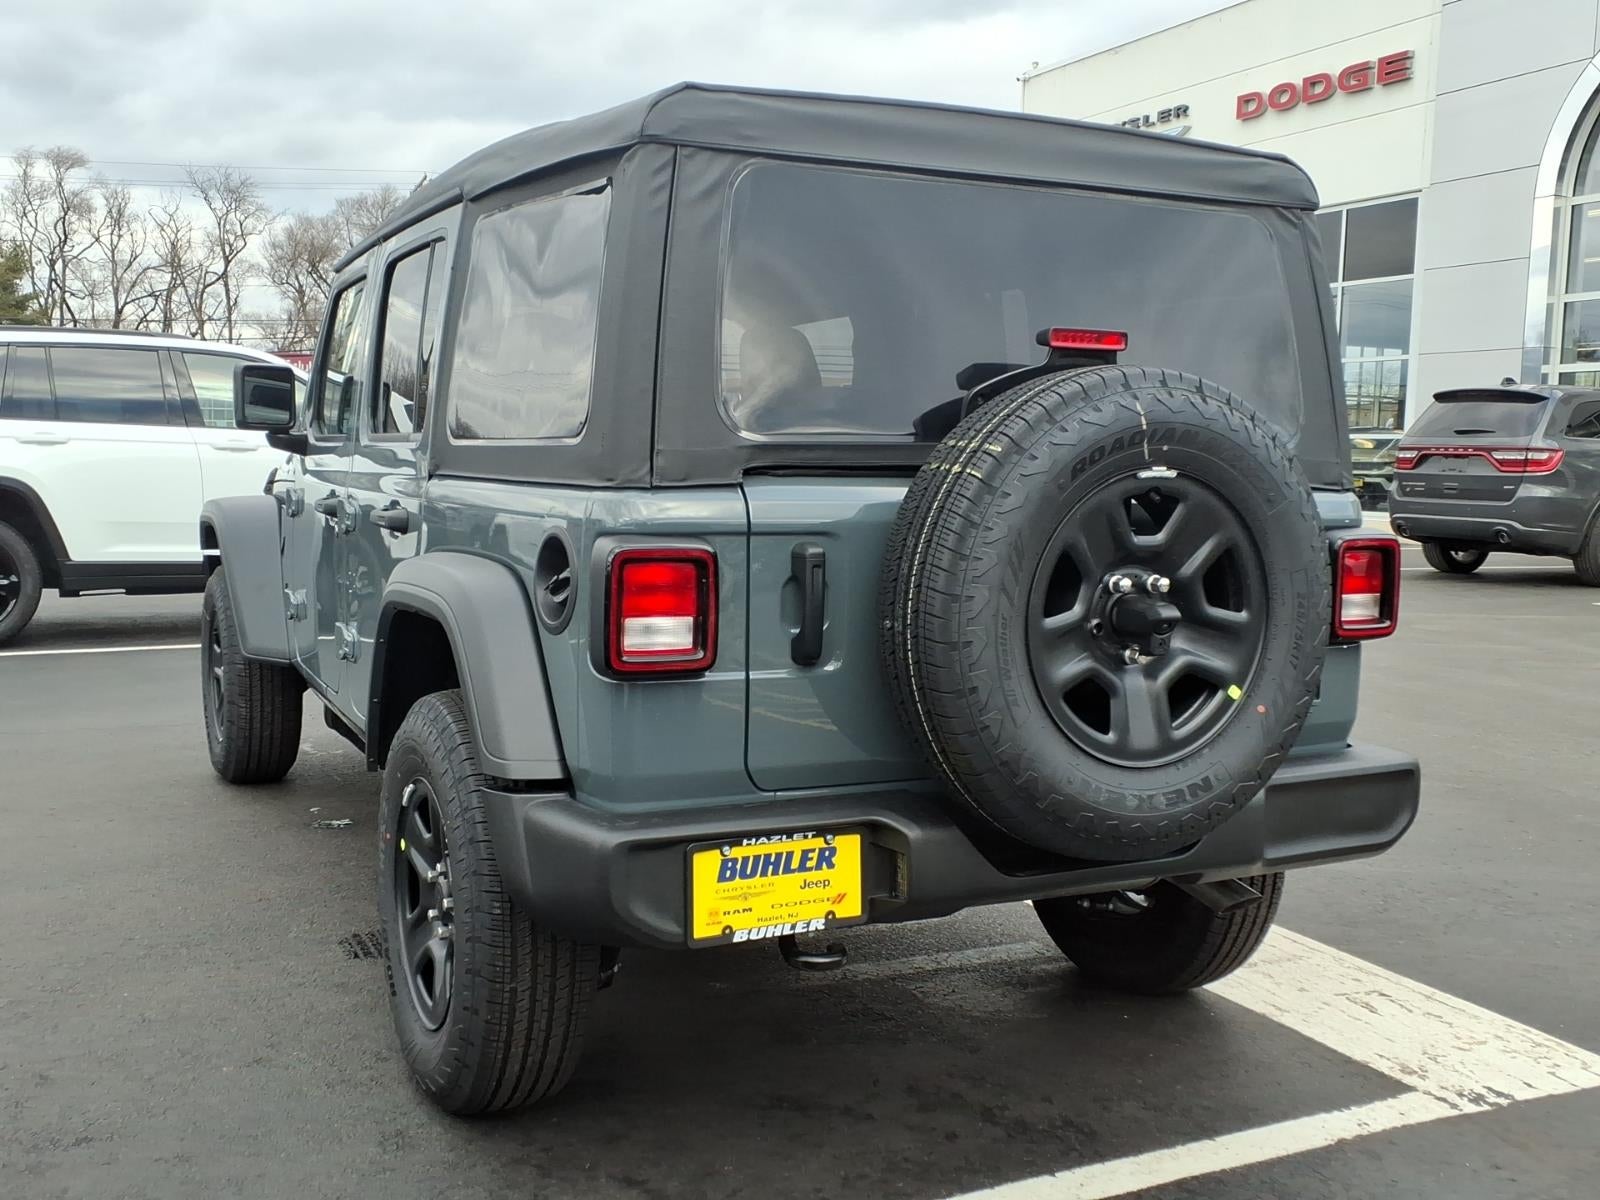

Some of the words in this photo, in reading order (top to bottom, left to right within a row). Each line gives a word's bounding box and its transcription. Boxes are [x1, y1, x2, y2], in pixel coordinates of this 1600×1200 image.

[1236, 49, 1415, 121] DODGE
[1118, 103, 1190, 129] SLER
[742, 831, 817, 847] HAZLET
[717, 846, 838, 883] BUHLER
[715, 882, 775, 895] CHRYSLER
[799, 878, 831, 890] Jeep
[722, 906, 753, 916] RAM
[770, 896, 835, 910] DODGE
[732, 917, 827, 943] BUHLER
